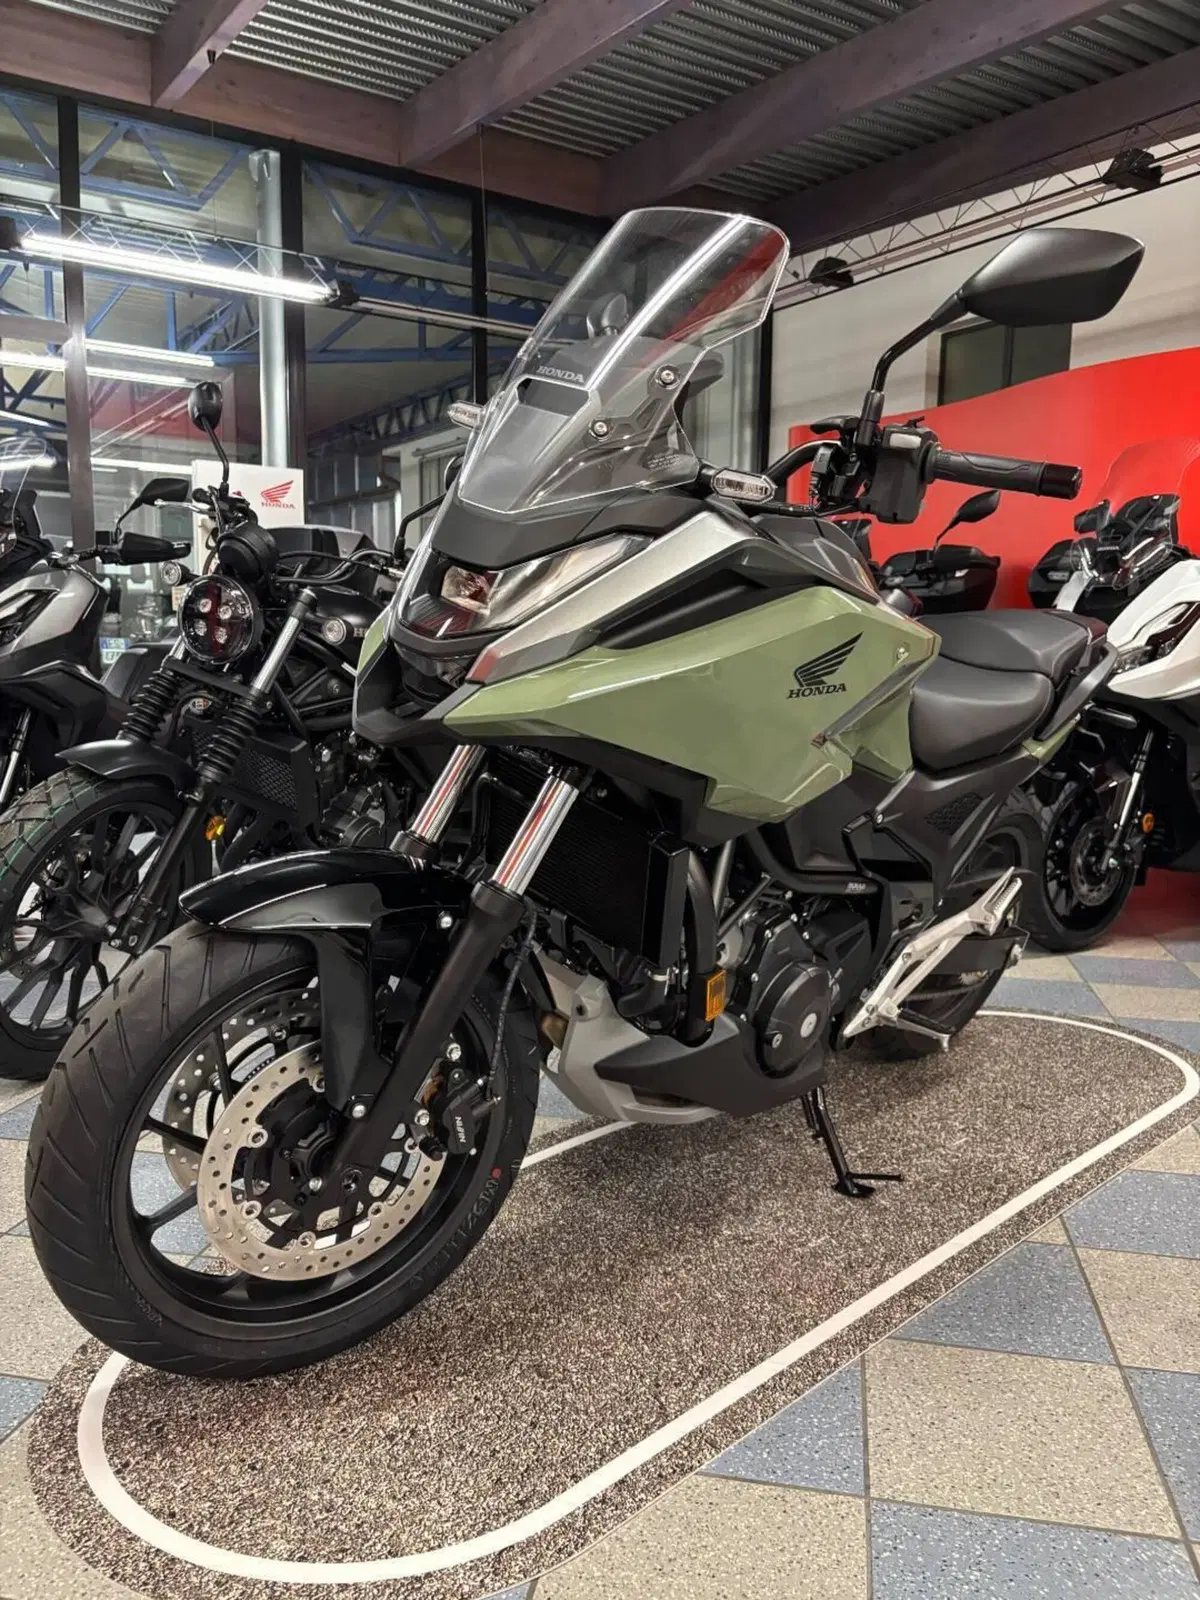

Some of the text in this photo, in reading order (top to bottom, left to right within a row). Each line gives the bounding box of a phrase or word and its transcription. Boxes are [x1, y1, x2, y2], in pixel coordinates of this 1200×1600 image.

[536, 365, 585, 383] HONDA
[261, 501, 296, 509] HONDA
[786, 683, 848, 699] HONDA
